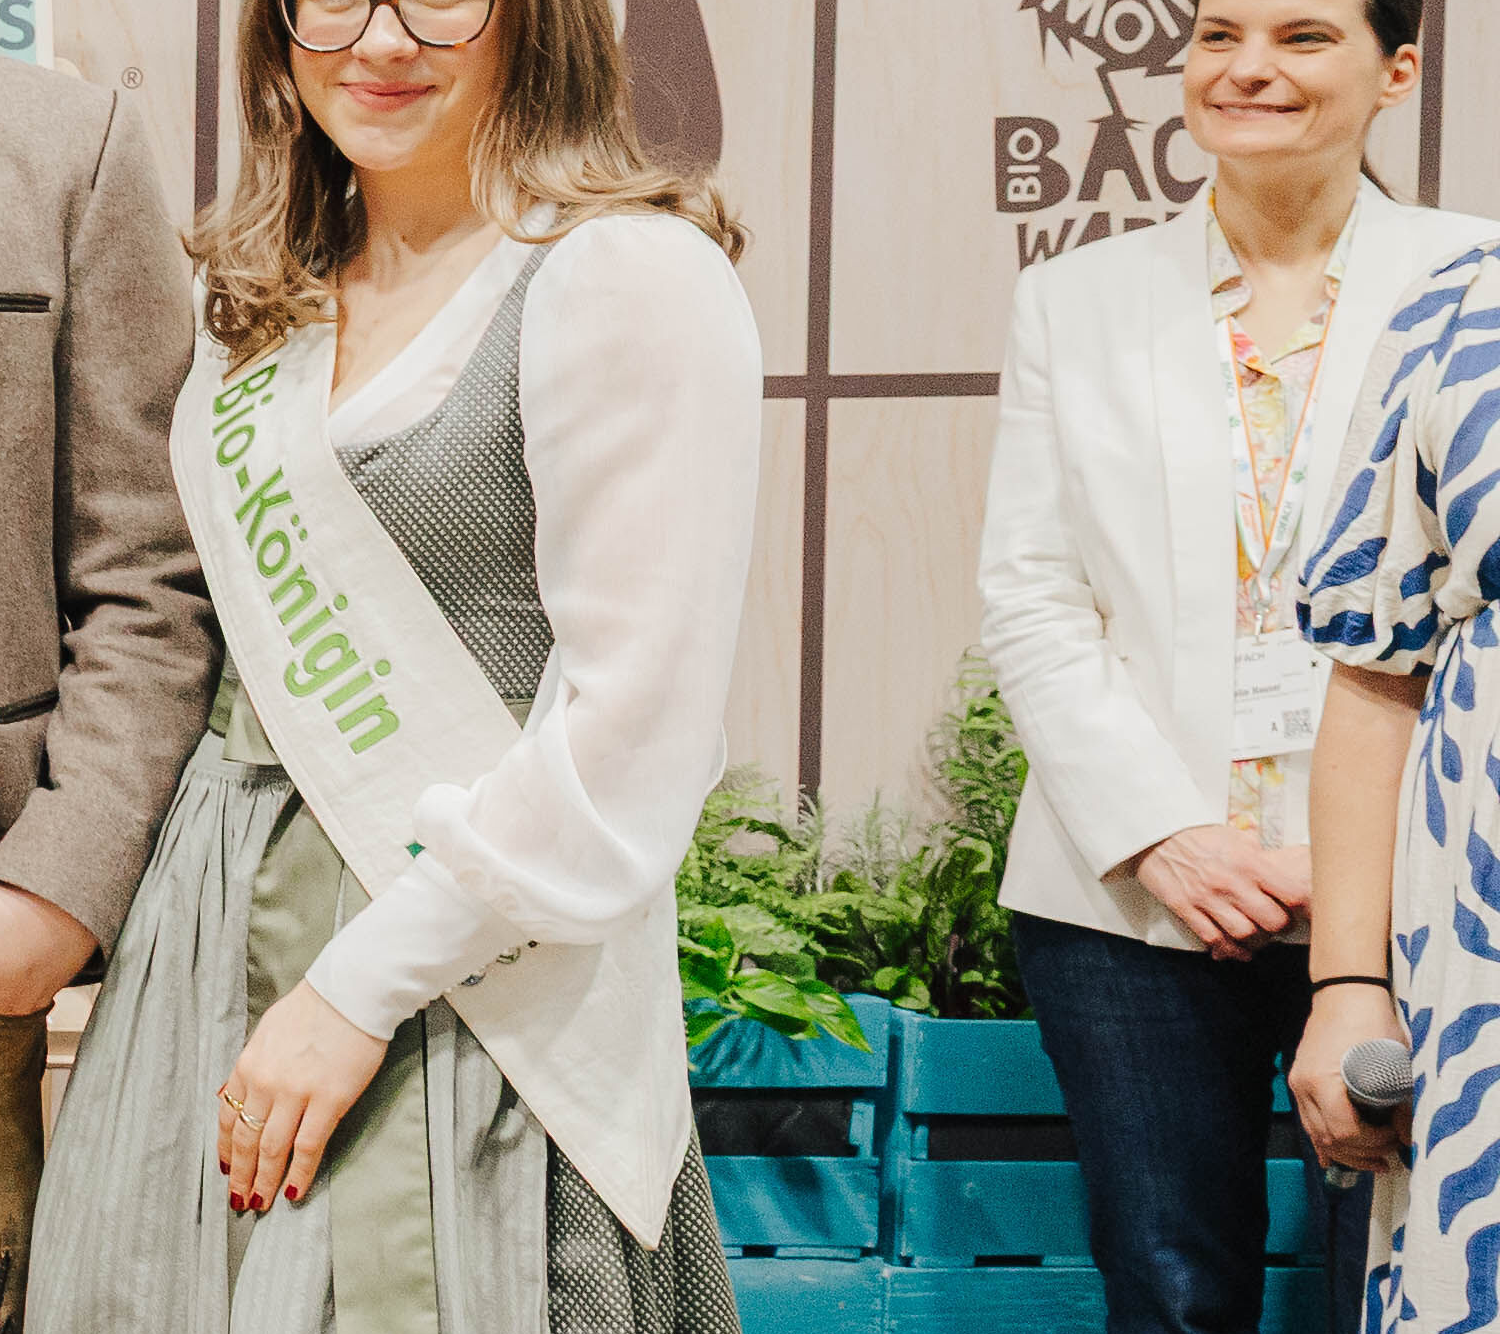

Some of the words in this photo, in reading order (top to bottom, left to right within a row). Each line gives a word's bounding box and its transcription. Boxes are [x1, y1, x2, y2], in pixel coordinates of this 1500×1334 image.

[995, 116, 1208, 213] BAC
[1007, 127, 1042, 203] BIO
[212, 363, 400, 755] Bio-Königin
